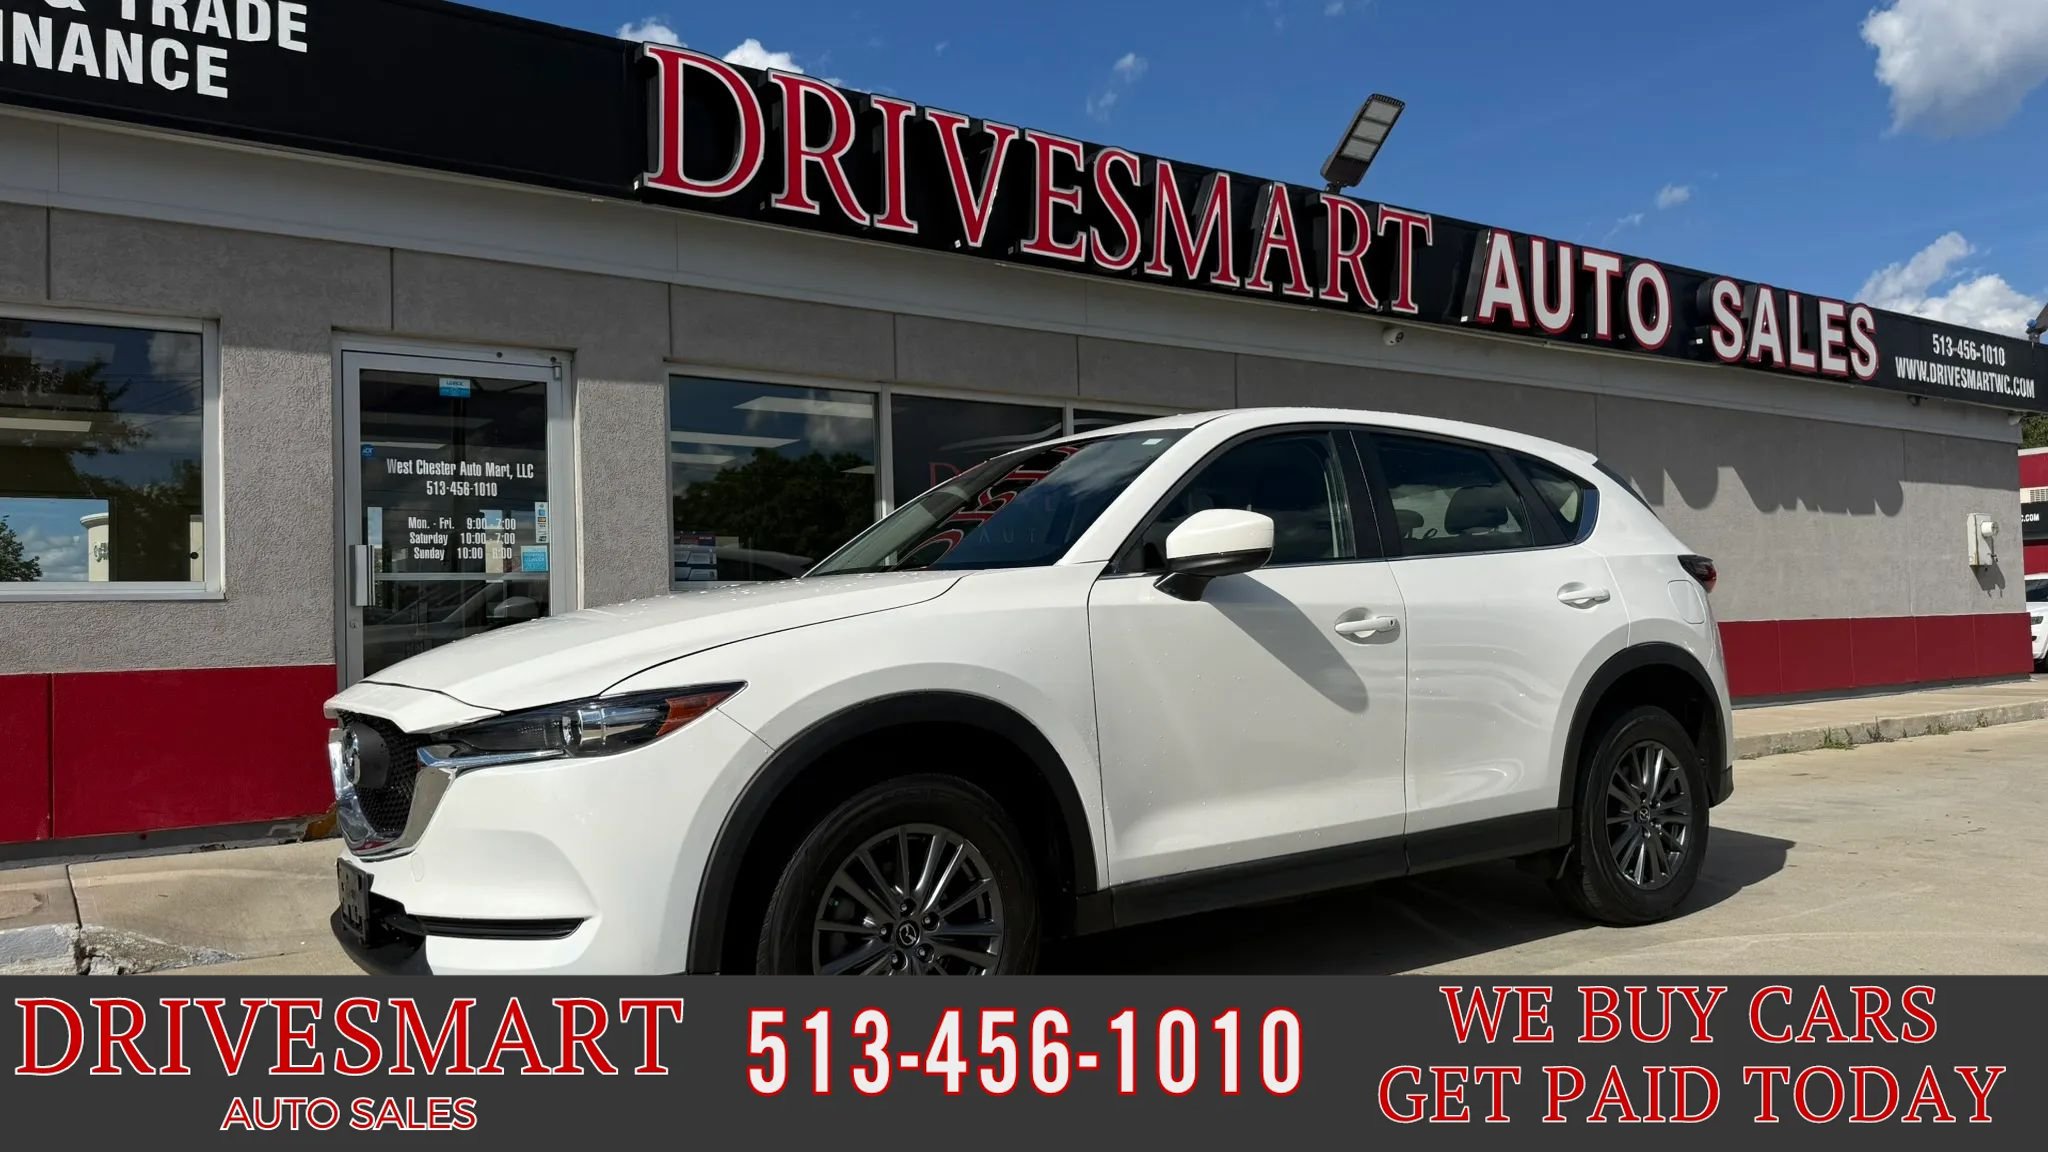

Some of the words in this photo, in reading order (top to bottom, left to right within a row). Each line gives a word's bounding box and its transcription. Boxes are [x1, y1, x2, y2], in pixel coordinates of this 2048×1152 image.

[0, 9, 229, 99] NANCE
[643, 41, 1433, 314] DRIVESMART
[1475, 227, 1671, 351] AUTO
[1709, 275, 1880, 381] SALES
[1932, 333, 2006, 367] 513-456-1010
[1895, 356, 2035, 399] WWW.DRIVESMARTWC.COM
[386, 458, 413, 474] West
[416, 459, 456, 476] Chester
[460, 461, 482, 477] Auto
[485, 462, 513, 480] Mart,
[517, 463, 534, 479] LLC
[426, 480, 498, 497] 513-456-1010
[408, 517, 430, 529] Mon.
[439, 517, 455, 529] Fri.
[466, 517, 487, 530] 9:00
[409, 532, 448, 546] Saturday
[460, 532, 486, 545] 10:00
[414, 547, 445, 561] Sunday
[457, 547, 484, 559] 10:00
